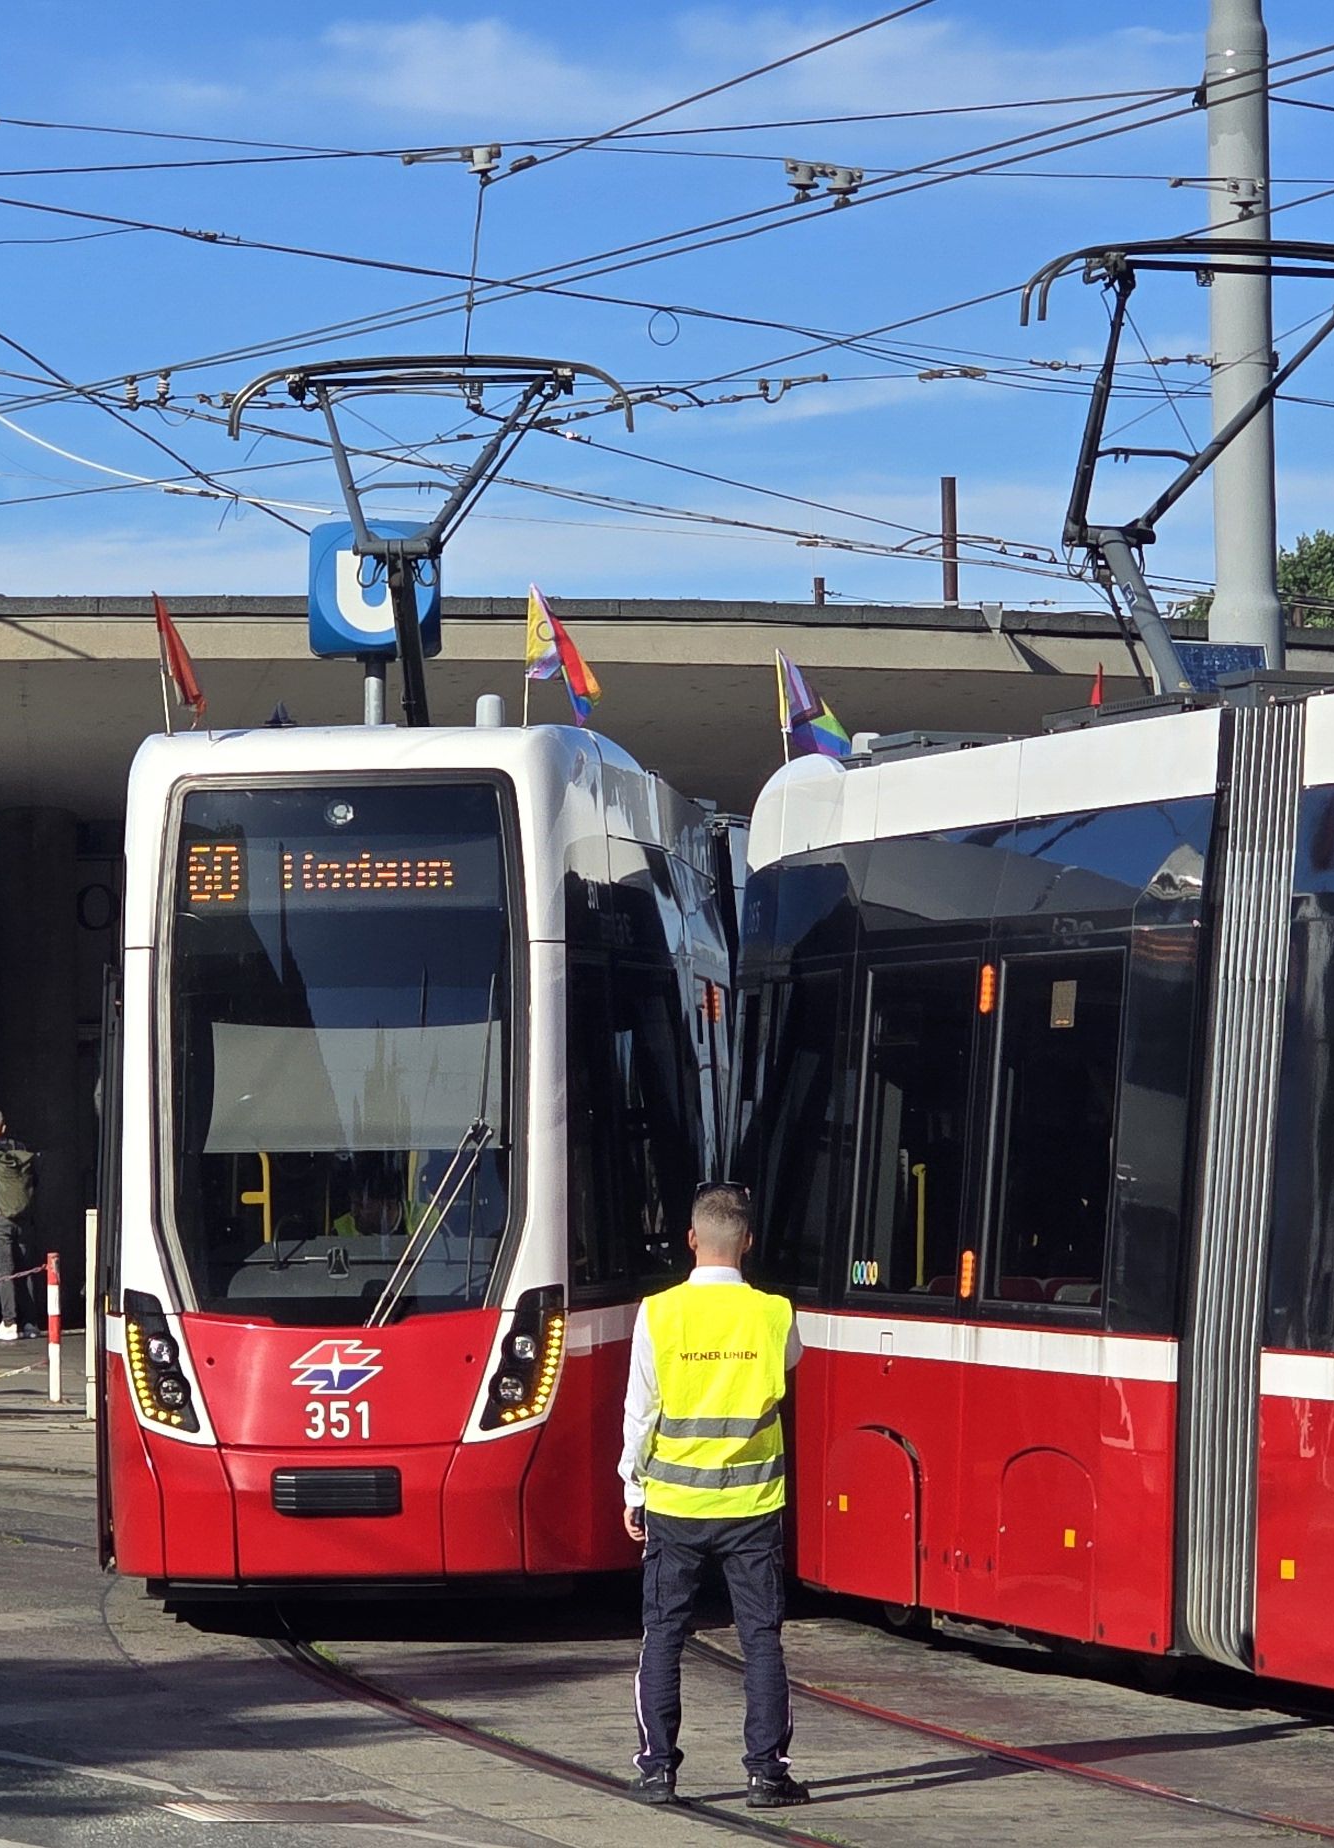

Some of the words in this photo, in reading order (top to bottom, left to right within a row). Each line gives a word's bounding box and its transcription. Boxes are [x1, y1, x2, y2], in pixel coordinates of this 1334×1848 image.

[336, 549, 414, 633] U
[723, 1350, 758, 1361] LINIEN
[304, 1400, 370, 1440] 351
